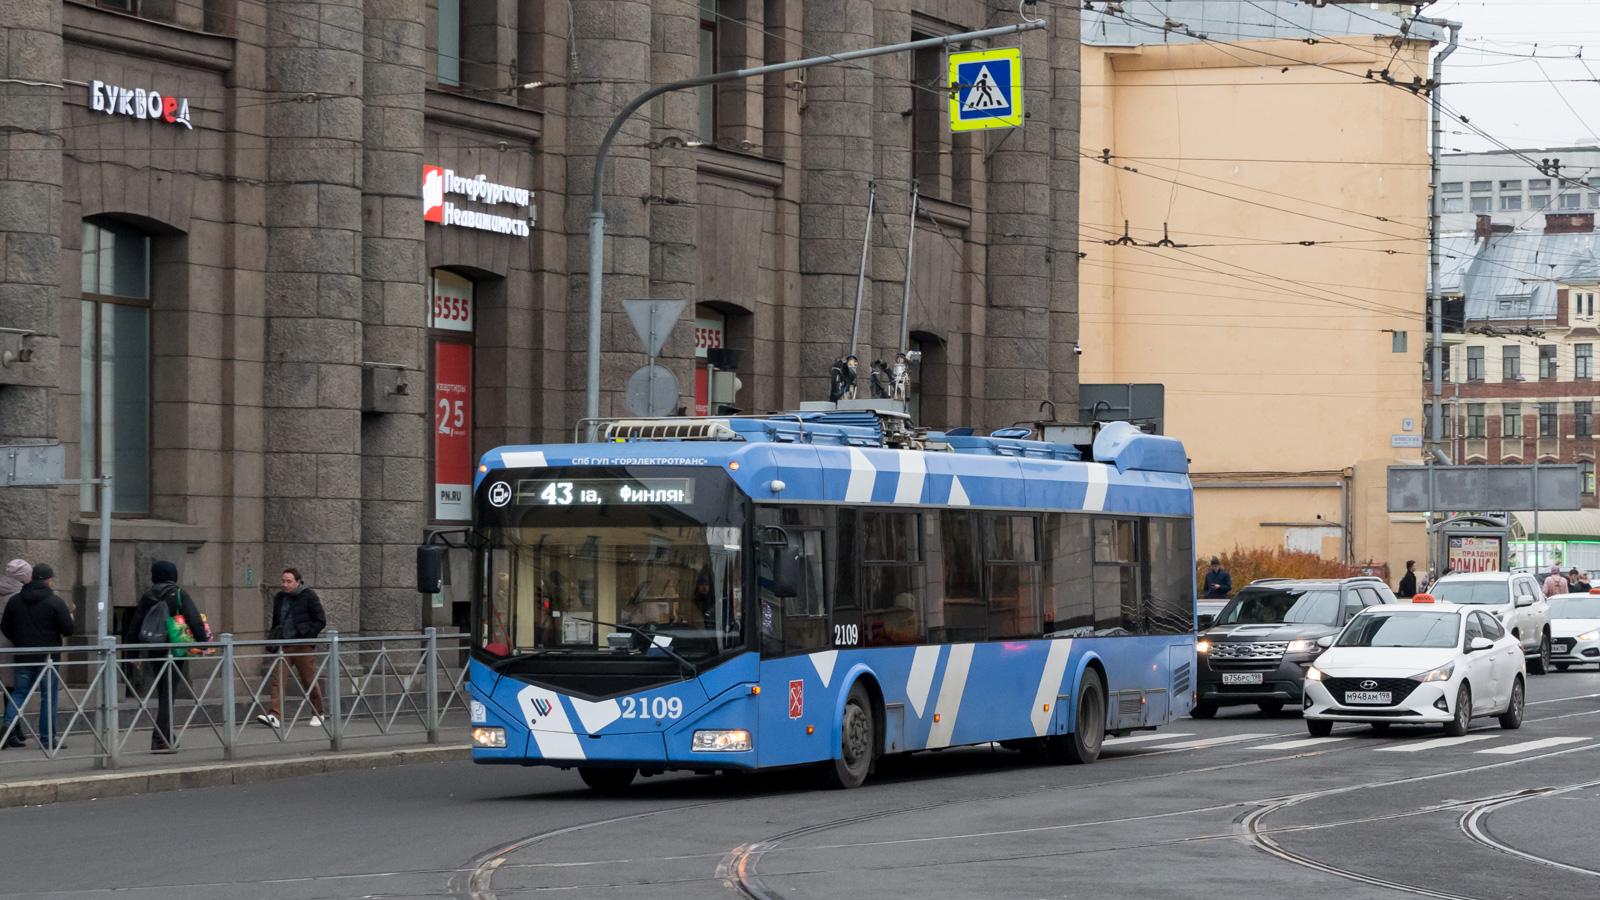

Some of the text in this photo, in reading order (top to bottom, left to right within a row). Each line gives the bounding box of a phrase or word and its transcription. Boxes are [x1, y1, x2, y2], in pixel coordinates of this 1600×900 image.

[444, 168, 530, 207] Петербургская
[443, 201, 530, 237] Недвижимость
[571, 457, 709, 466] СПб ГУП «ГОРЭЛЕКТРОТРАНС»
[440, 490, 462, 502] PN.RU
[541, 482, 574, 505] 43
[1463, 538, 1474, 546] 26
[1461, 550, 1499, 558] ПРАЗДНИК
[1449, 557, 1498, 573] РОМАНСА
[834, 623, 859, 646] 2109
[1346, 692, 1391, 701] М948АМ 198
[621, 696, 683, 720] 2109
